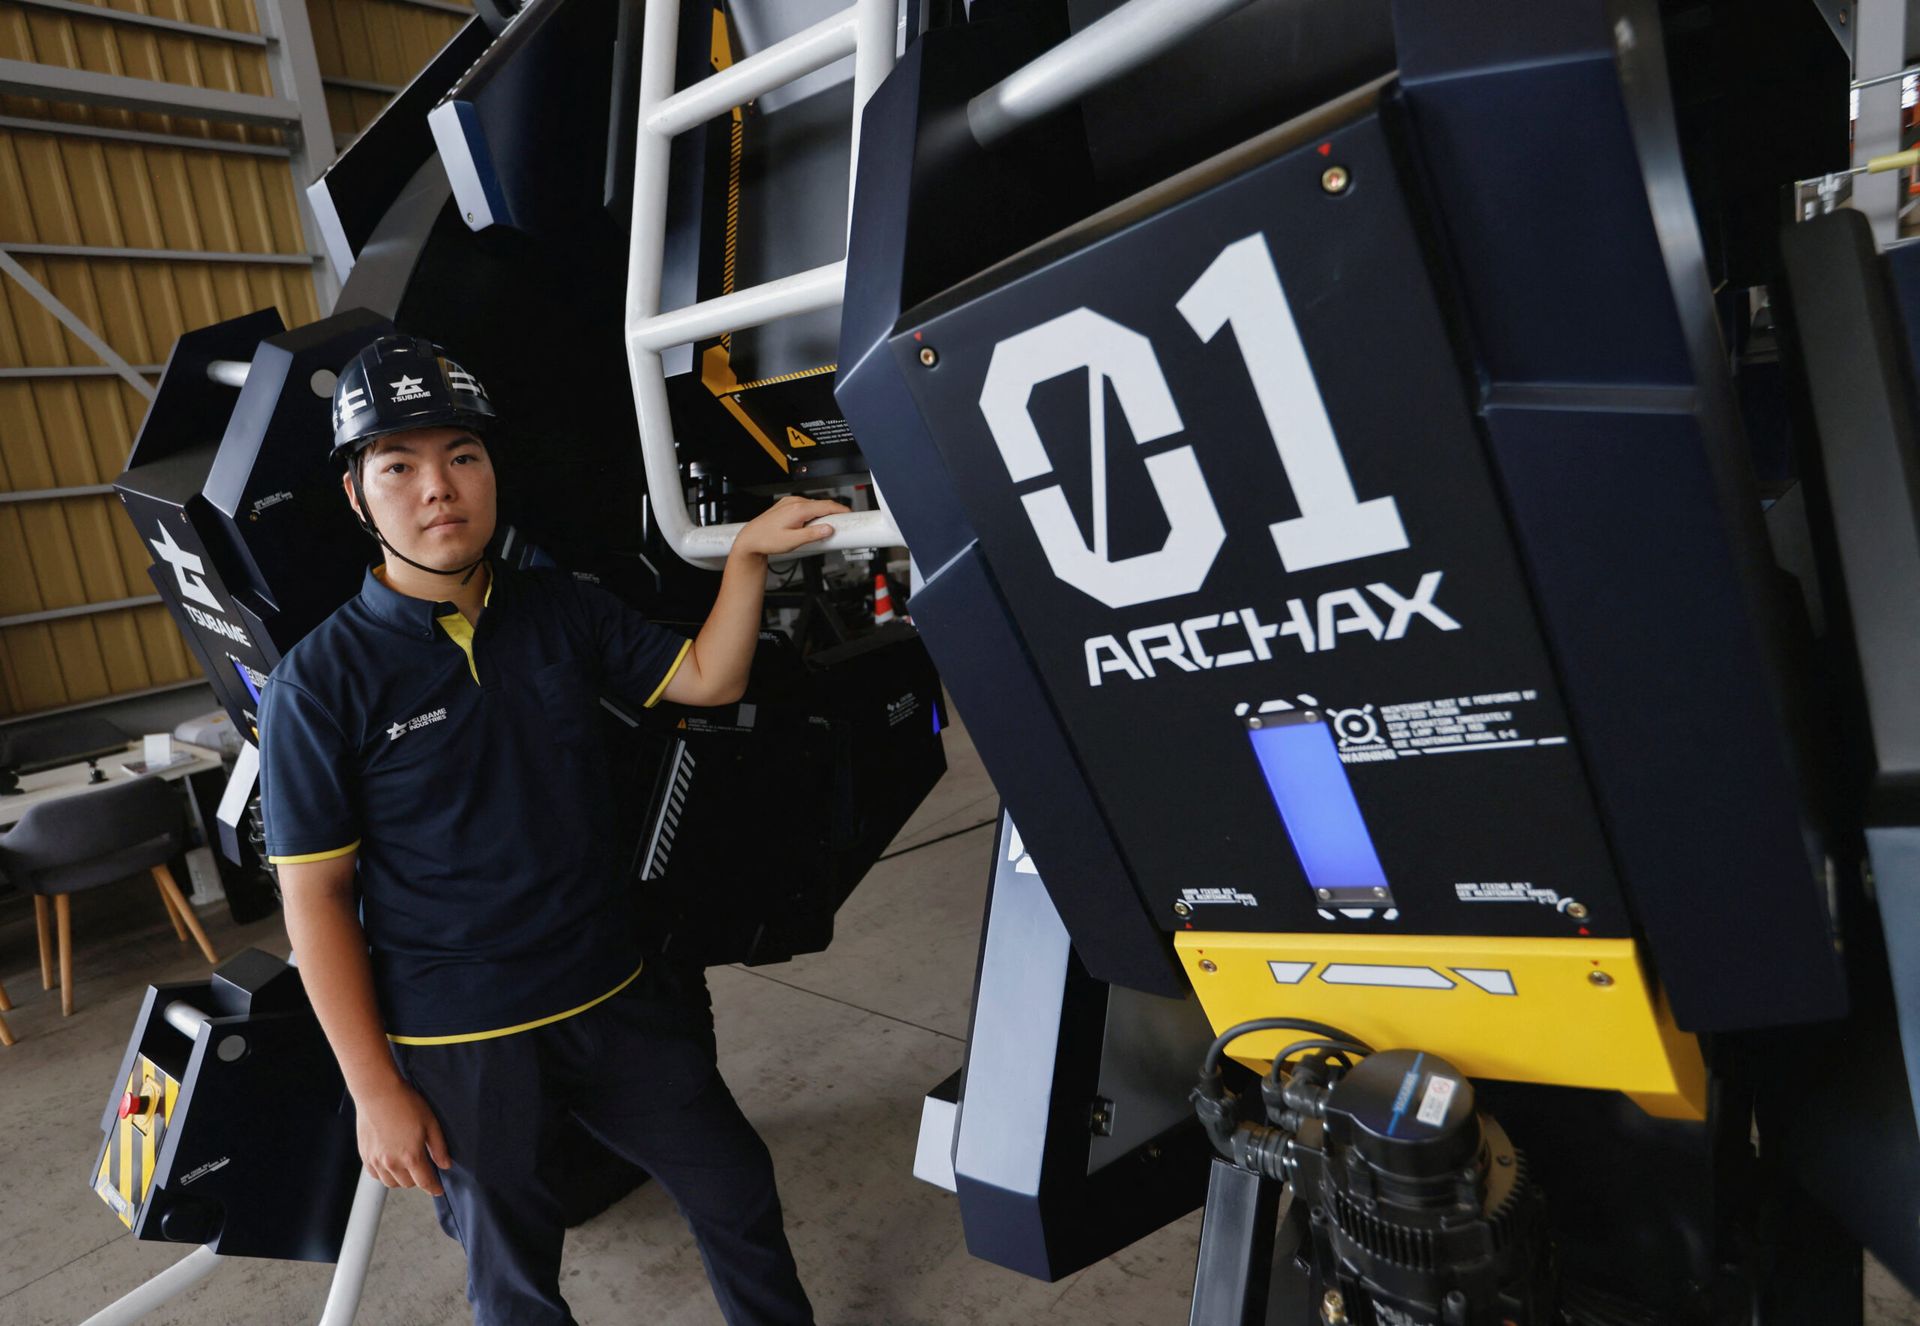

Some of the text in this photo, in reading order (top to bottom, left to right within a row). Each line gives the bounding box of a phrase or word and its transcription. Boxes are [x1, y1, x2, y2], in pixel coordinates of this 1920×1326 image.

[391, 391, 432, 403] TSUBAME
[979, 231, 1411, 609] 01
[182, 602, 252, 647] TSUBAME
[1084, 571, 1462, 687] ARCHAX
[408, 707, 447, 726] TSUBAME
[409, 714, 447, 731] INDUSTRIES
[1338, 749, 1398, 764] WARNING
